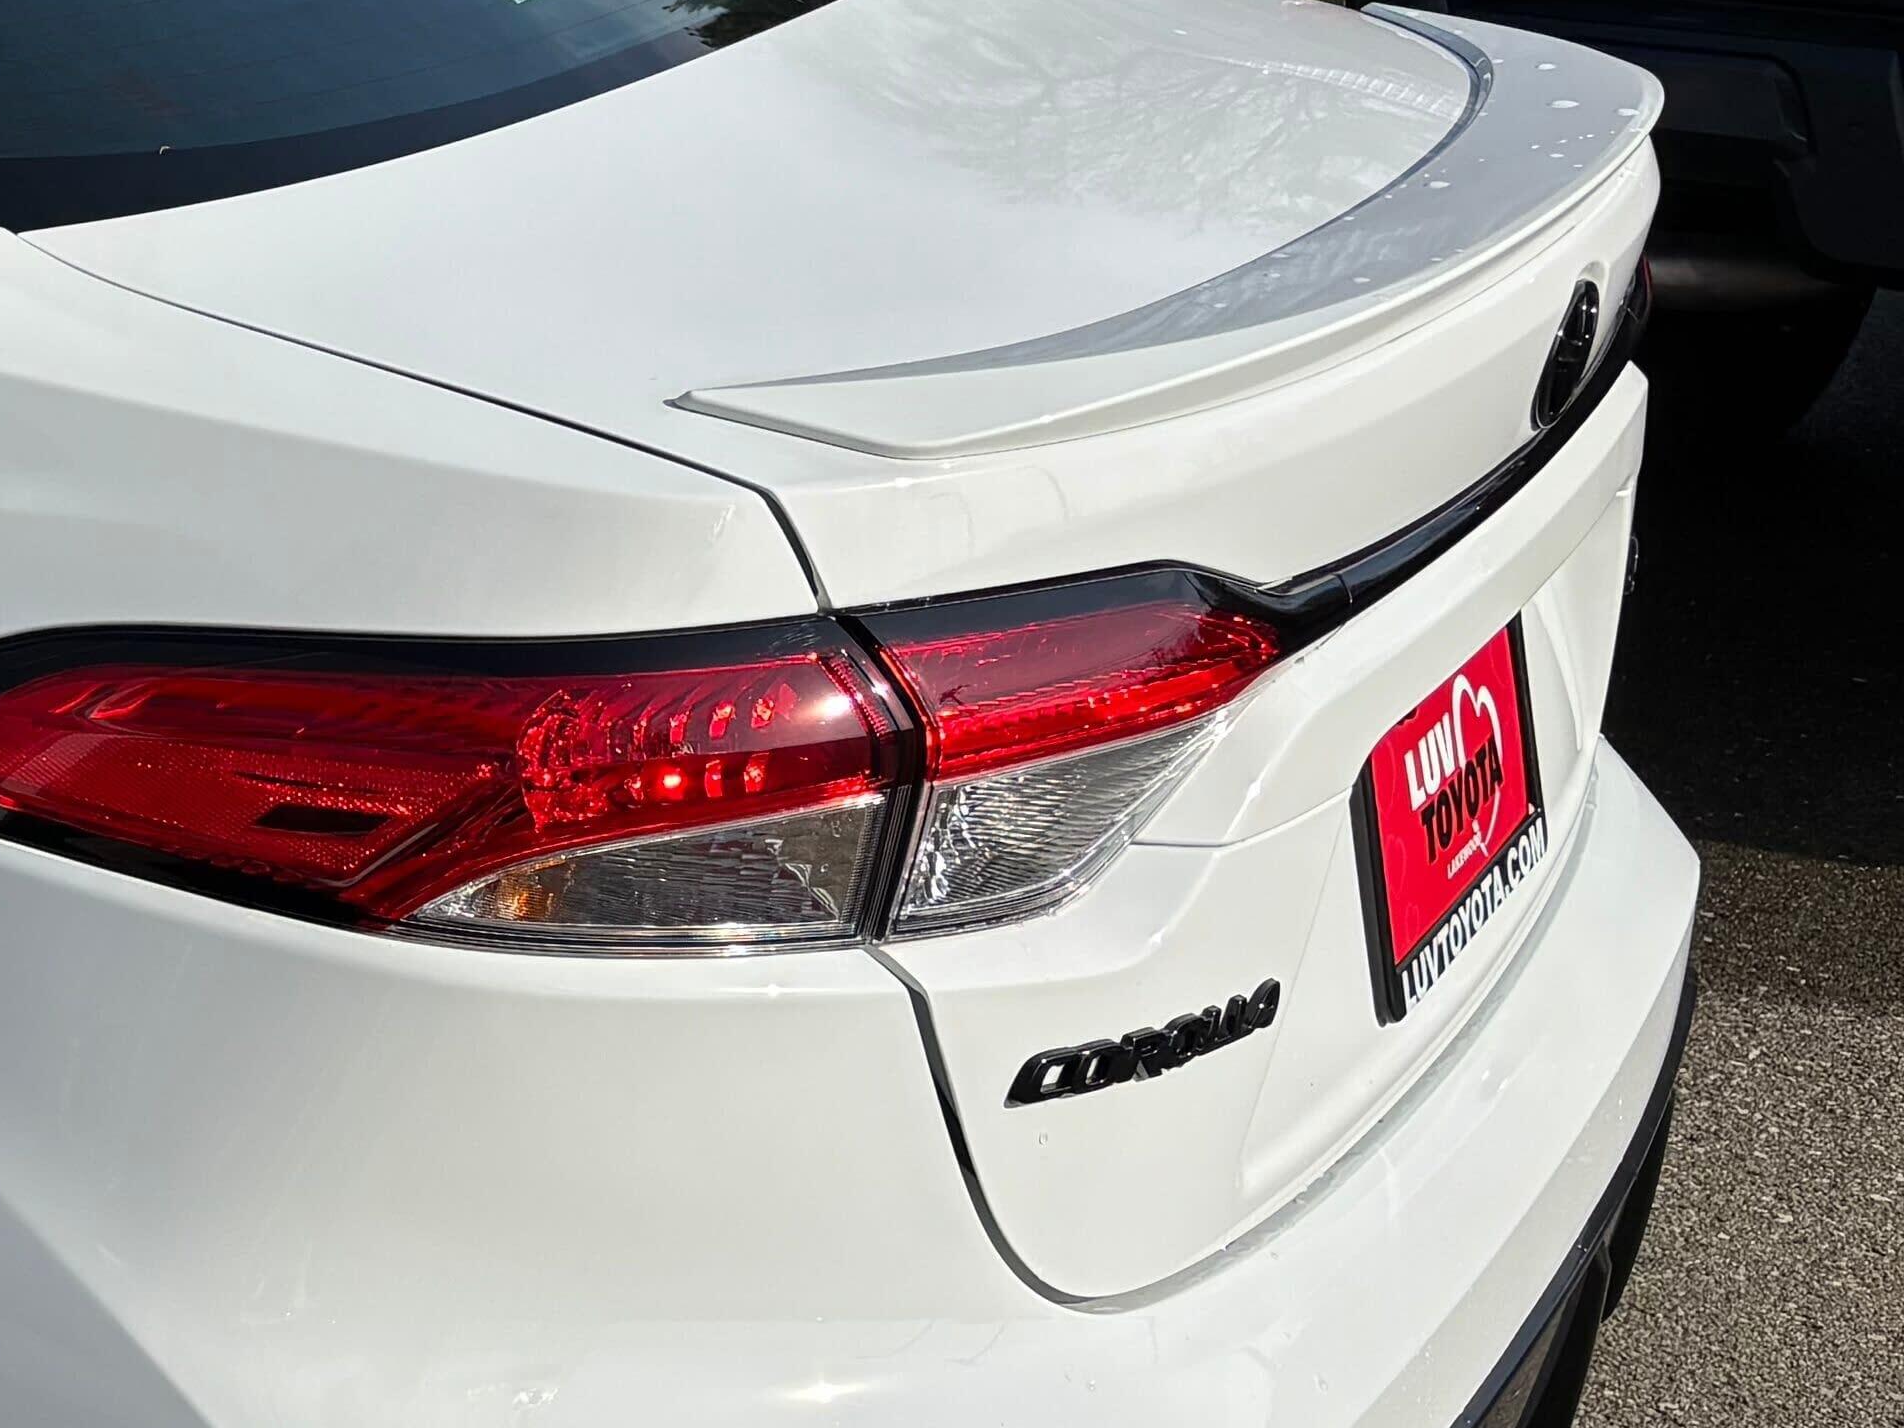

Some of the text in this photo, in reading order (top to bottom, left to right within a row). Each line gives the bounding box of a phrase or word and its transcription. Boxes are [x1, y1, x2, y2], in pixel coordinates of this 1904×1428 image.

[1404, 712, 1457, 812] LUV
[1419, 731, 1505, 865] TOYOTA
[1401, 816, 1544, 1012] LUVTOYOTA.COM
[1003, 977, 1282, 1110] COROLLA
